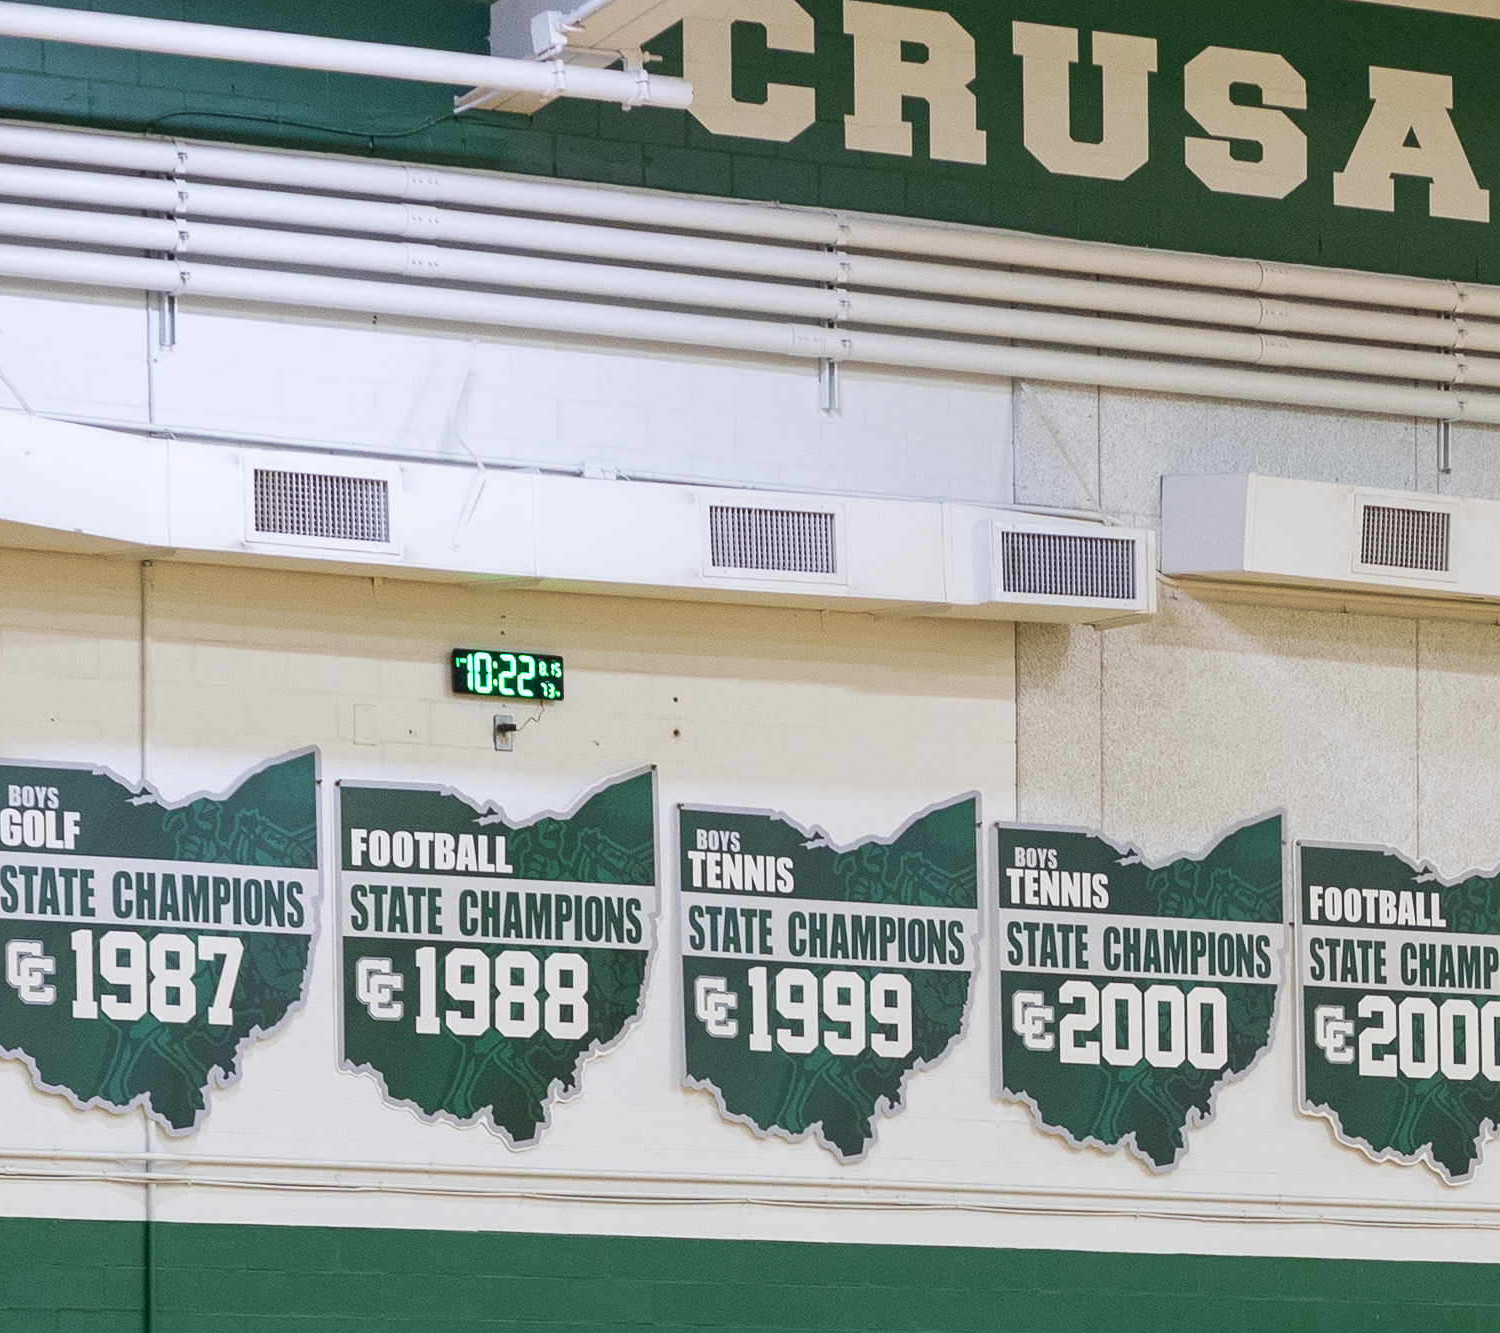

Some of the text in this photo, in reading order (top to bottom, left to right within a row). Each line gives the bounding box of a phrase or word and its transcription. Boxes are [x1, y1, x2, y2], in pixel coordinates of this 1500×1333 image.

[467, 651, 535, 697] 10:22
[8, 784, 59, 809] BOYS
[0, 808, 81, 850] GOLF
[351, 828, 513, 874] FOOTBALL
[696, 828, 741, 852] BOYS
[688, 850, 794, 894] TENNIS
[1014, 847, 1058, 870] BOYS
[0, 866, 305, 929] STATE CHAMPIONS
[1006, 867, 1109, 909] TENNIS
[1309, 885, 1446, 929] FOOTBALL
[350, 883, 642, 945] STATE CHAMPIONS
[688, 905, 964, 966] STATE CHAMPIONS
[1007, 925, 1272, 979] STATE CHAMPIONS
[1309, 938, 1387, 985] STATE
[71, 930, 244, 1026] 1987
[415, 947, 589, 1040] 1988
[749, 966, 912, 1059] 1999
[1059, 981, 1228, 1071] 2000
